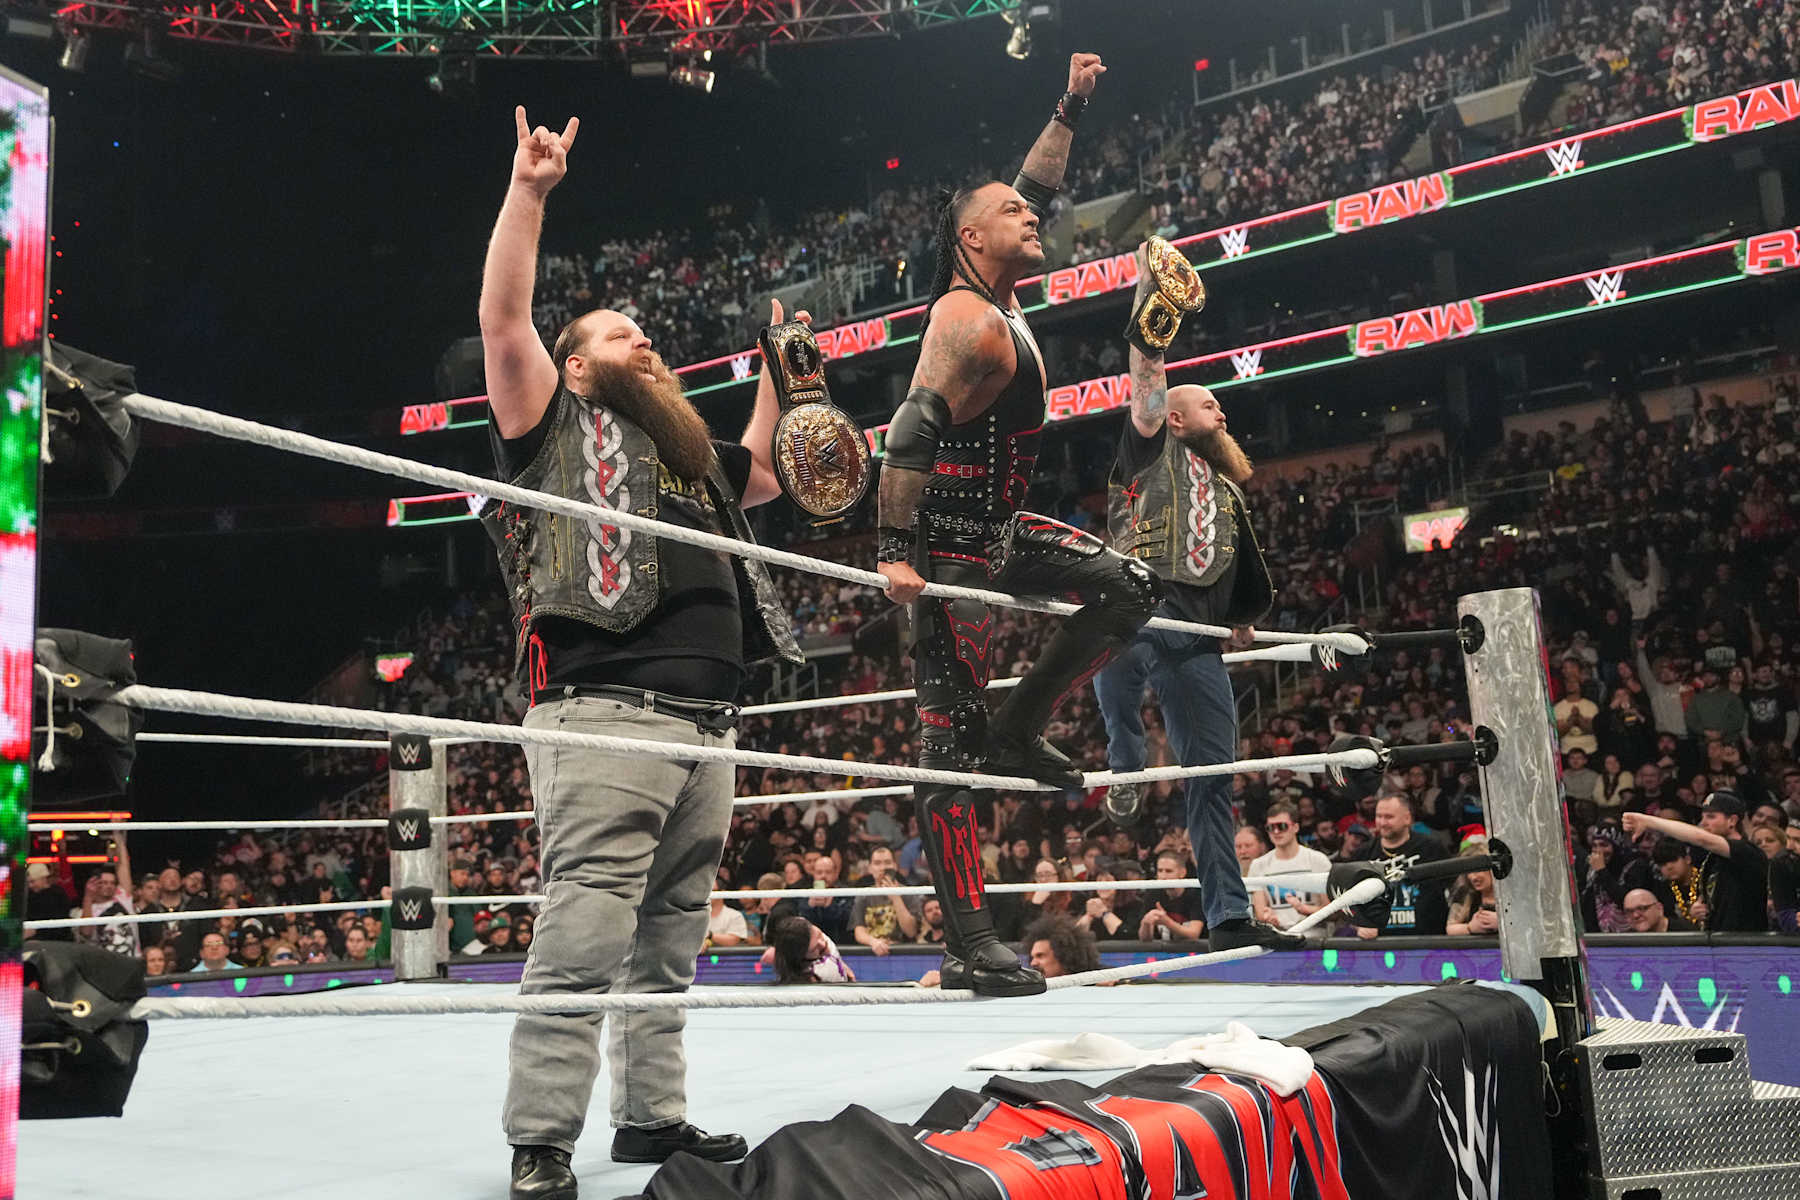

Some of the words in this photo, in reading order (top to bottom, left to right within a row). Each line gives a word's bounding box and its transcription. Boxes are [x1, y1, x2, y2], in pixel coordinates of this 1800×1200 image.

[1335, 174, 1448, 233] RAW
[1048, 252, 1141, 305] RAW
[815, 317, 887, 363] RAW
[1355, 300, 1478, 357] RAW
[401, 402, 448, 435] AW
